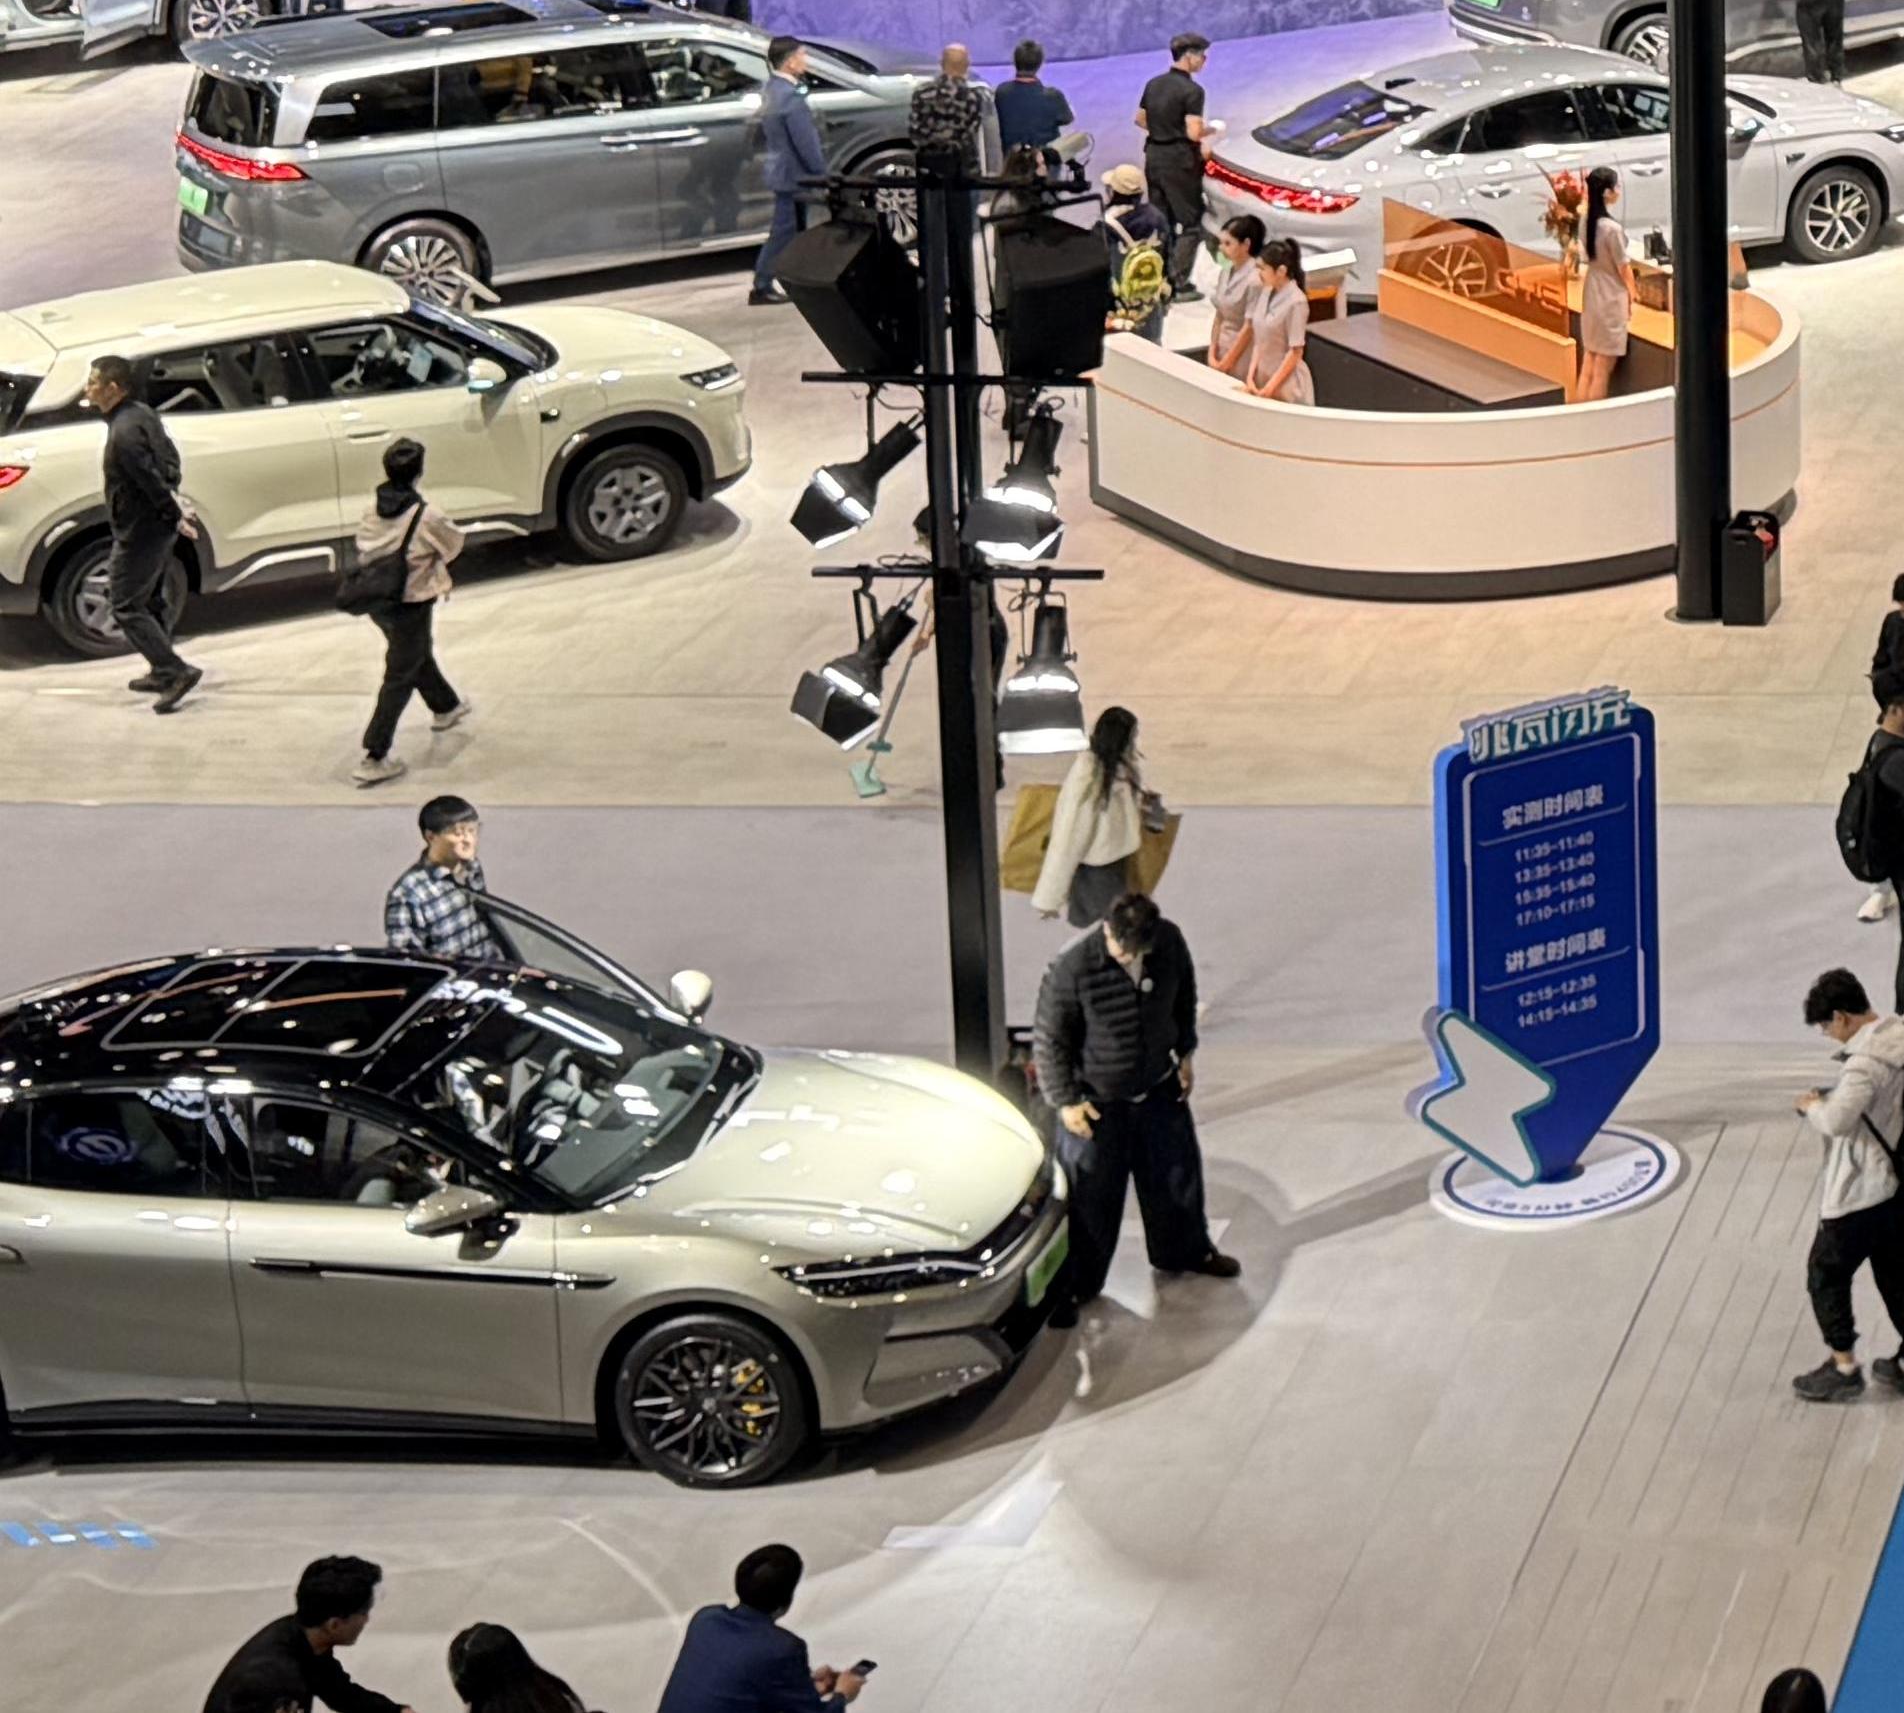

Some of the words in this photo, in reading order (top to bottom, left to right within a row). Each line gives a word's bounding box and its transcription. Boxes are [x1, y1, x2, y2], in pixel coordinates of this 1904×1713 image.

[1470, 691, 1632, 763] 兆瓦闪充
[1502, 783, 1604, 829] 实测时间表
[1505, 928, 1607, 973] 讲堂时间表
